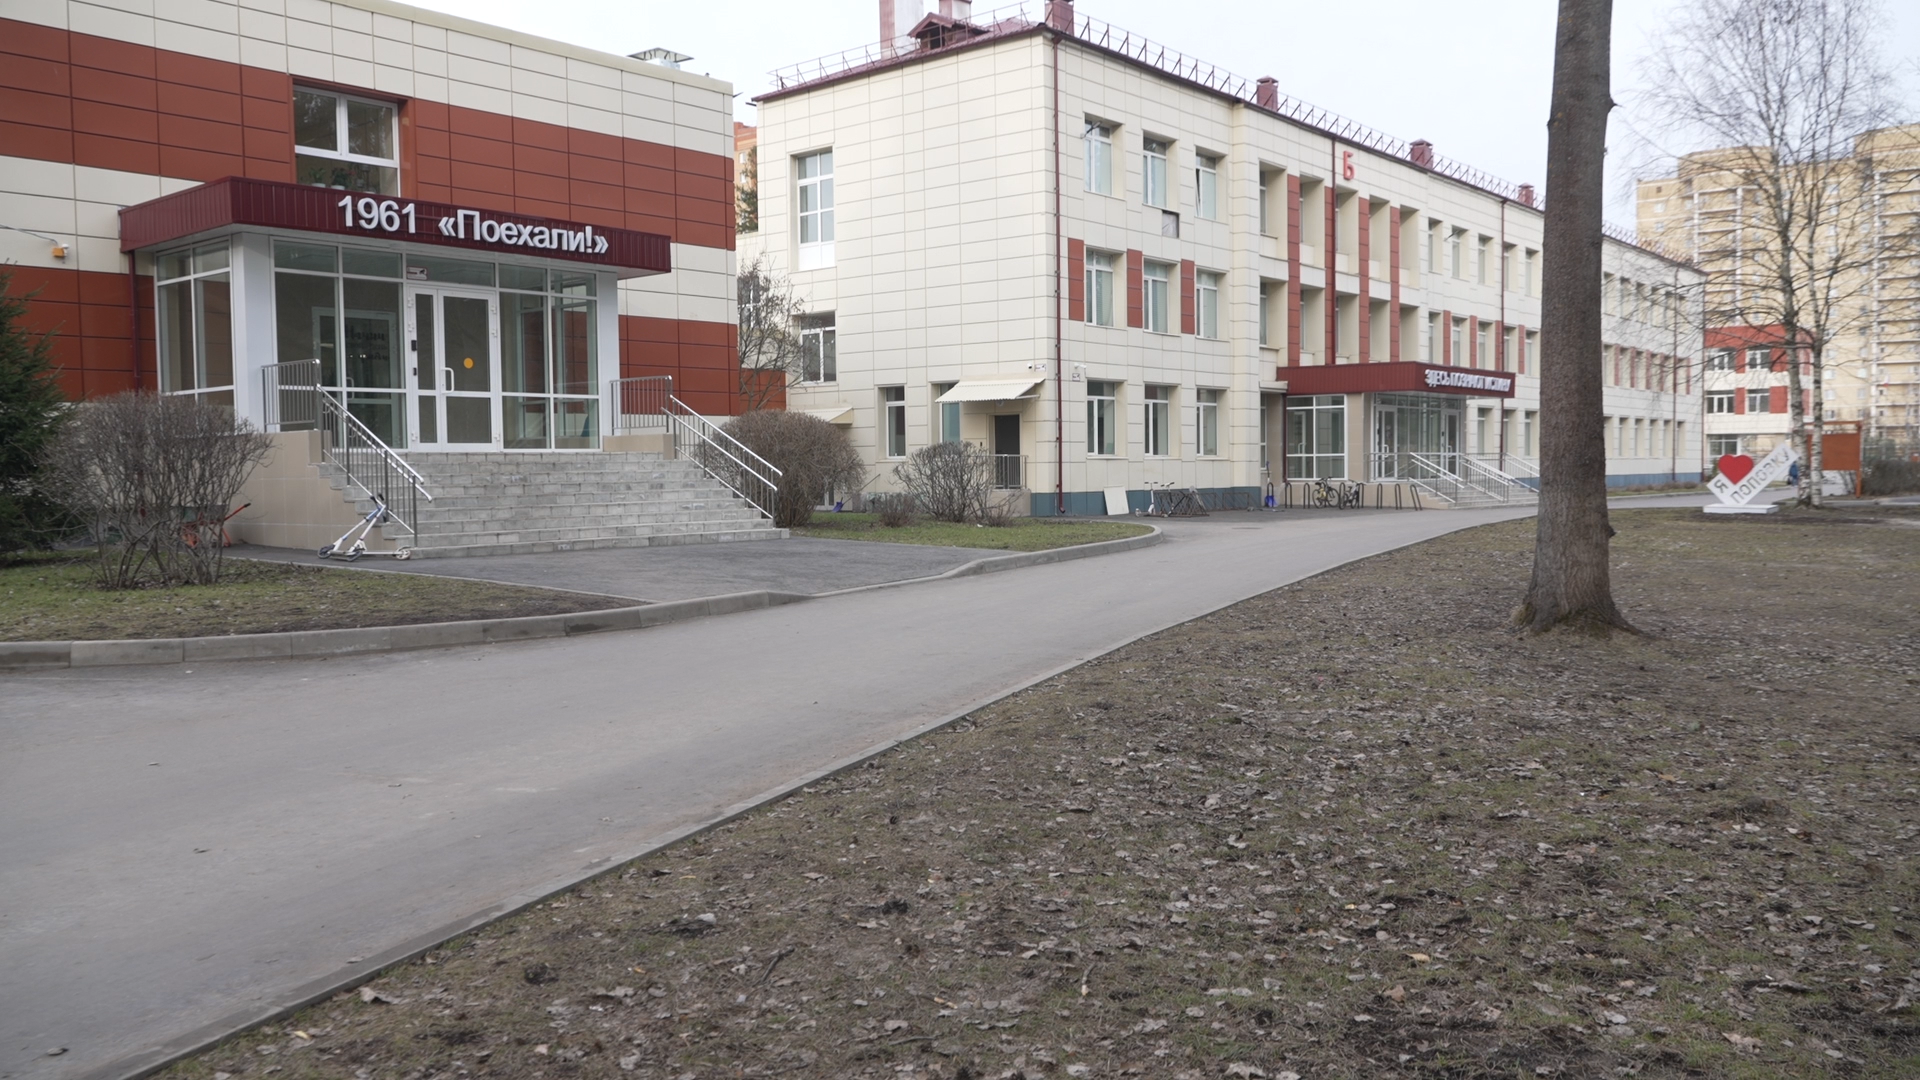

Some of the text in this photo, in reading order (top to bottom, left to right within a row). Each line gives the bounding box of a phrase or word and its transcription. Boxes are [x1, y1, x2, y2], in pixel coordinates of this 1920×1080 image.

[1343, 151, 1354, 180] Б
[338, 195, 609, 253] 1961 «Поехали!»
[1425, 369, 1450, 387] ЗДЕСЬ
[1714, 479, 1728, 493] Я
